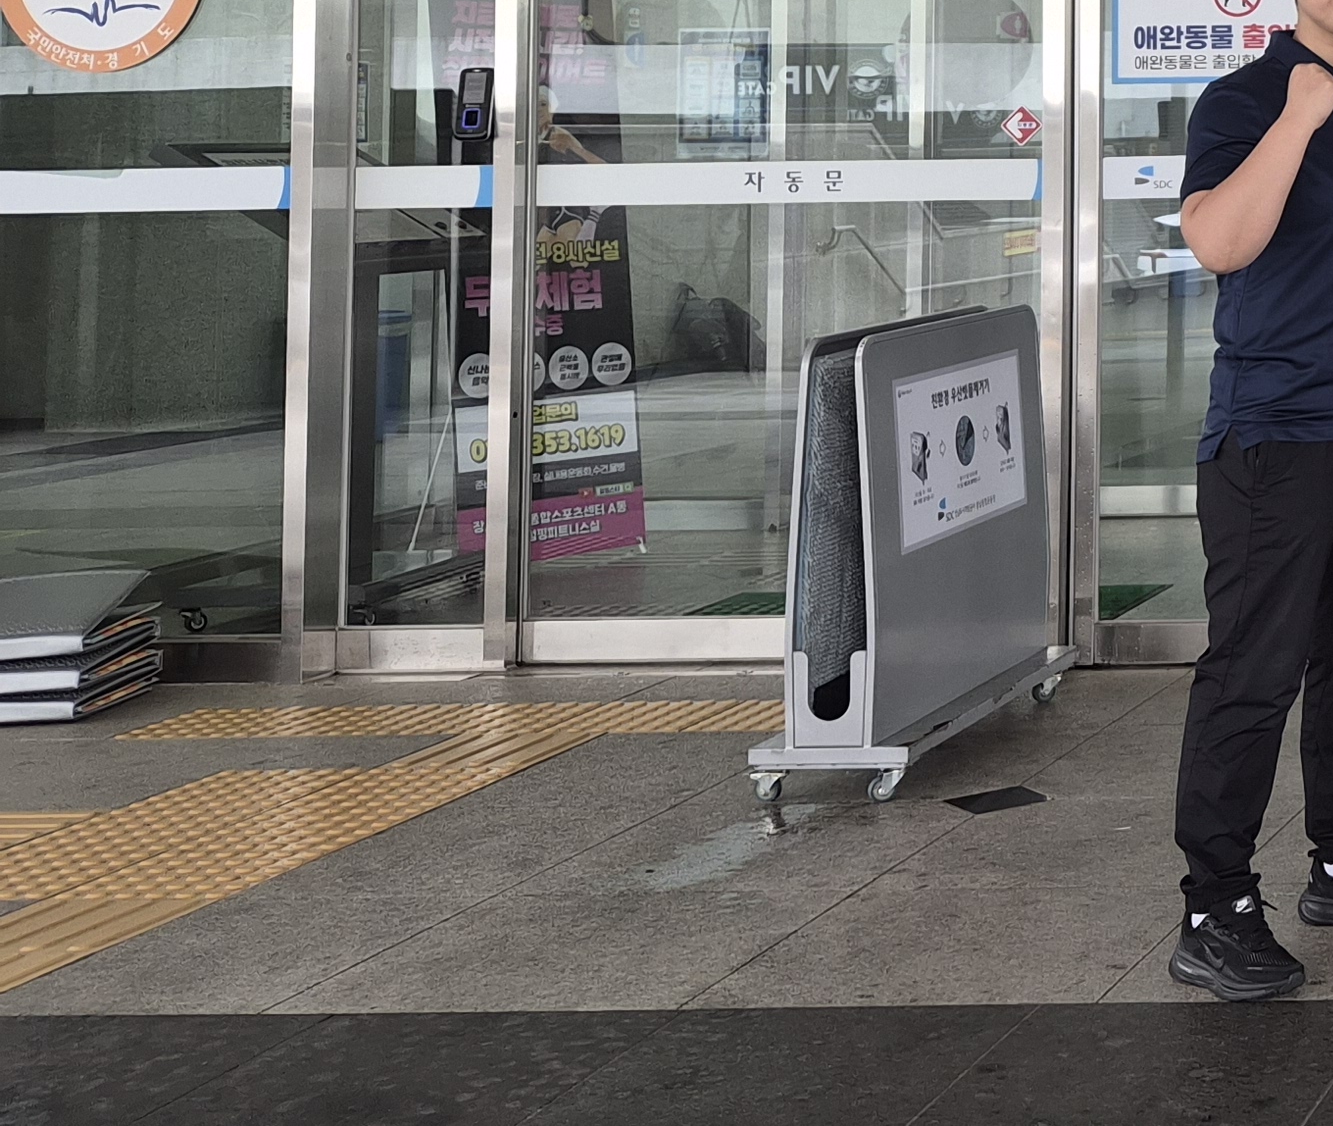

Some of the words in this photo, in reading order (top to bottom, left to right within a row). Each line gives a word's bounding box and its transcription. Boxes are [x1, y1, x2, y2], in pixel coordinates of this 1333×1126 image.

[1133, 25, 1234, 51] 애완동물
[1134, 54, 1208, 71] 애완동물은
[744, 170, 844, 193] 자동문
[1153, 179, 1173, 189] SDC
